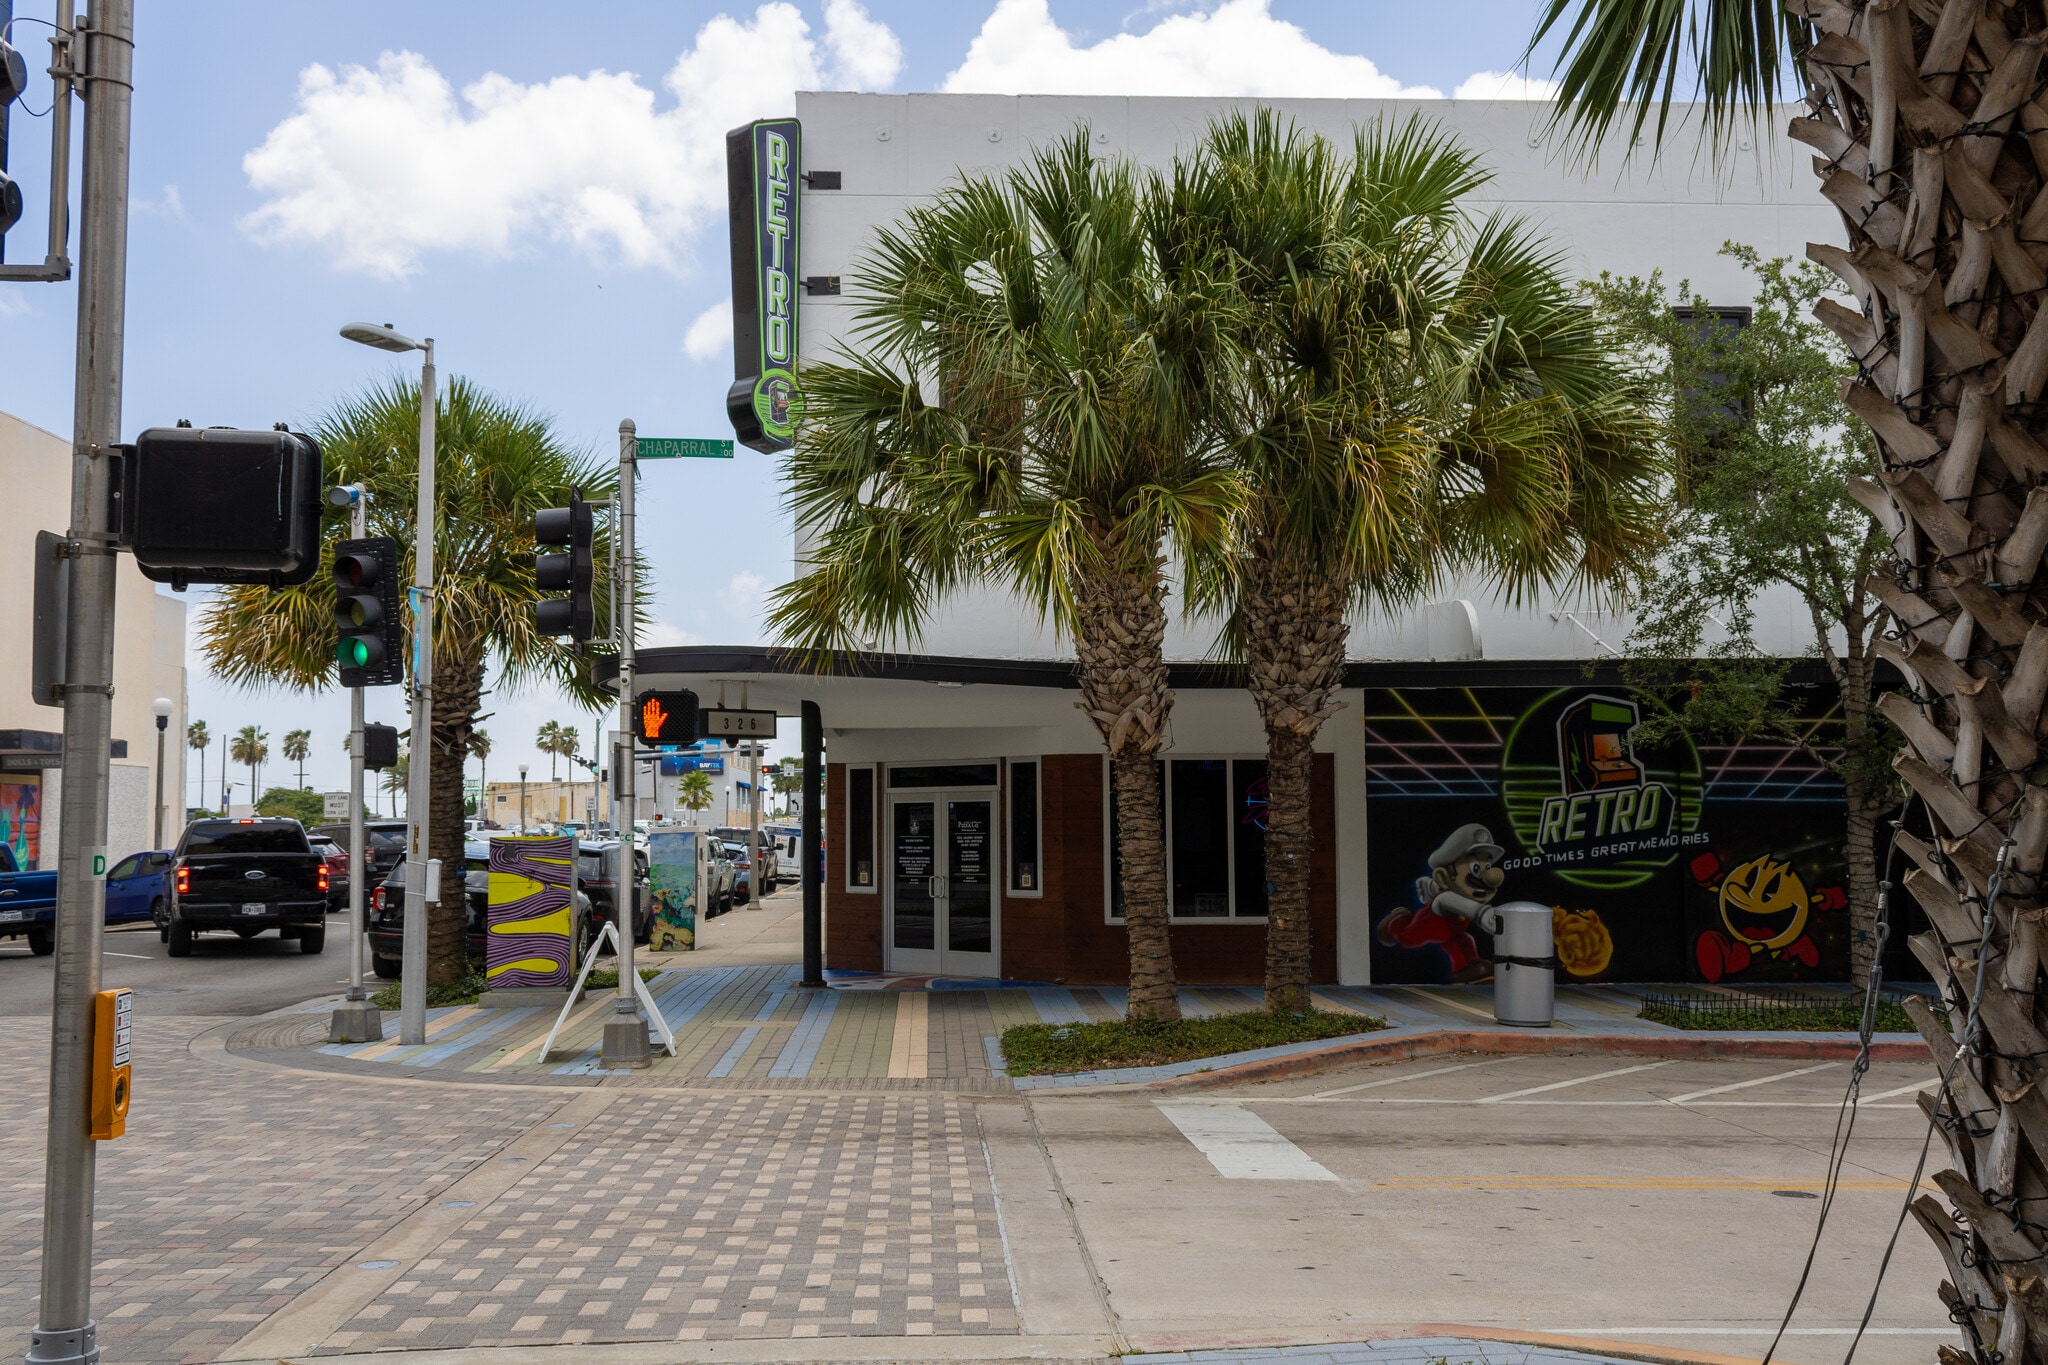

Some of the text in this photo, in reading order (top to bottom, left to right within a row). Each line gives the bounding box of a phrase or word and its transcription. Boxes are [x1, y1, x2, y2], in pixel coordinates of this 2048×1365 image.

[766, 130, 789, 364] RETRO
[638, 440, 731, 455] CHAPARRAL ST
[1541, 785, 1662, 845] RETRO
[93, 855, 106, 876] D
[1503, 857, 1542, 870] GOOD
[1545, 850, 1584, 863] TIMES
[1591, 841, 1637, 857] GREAT
